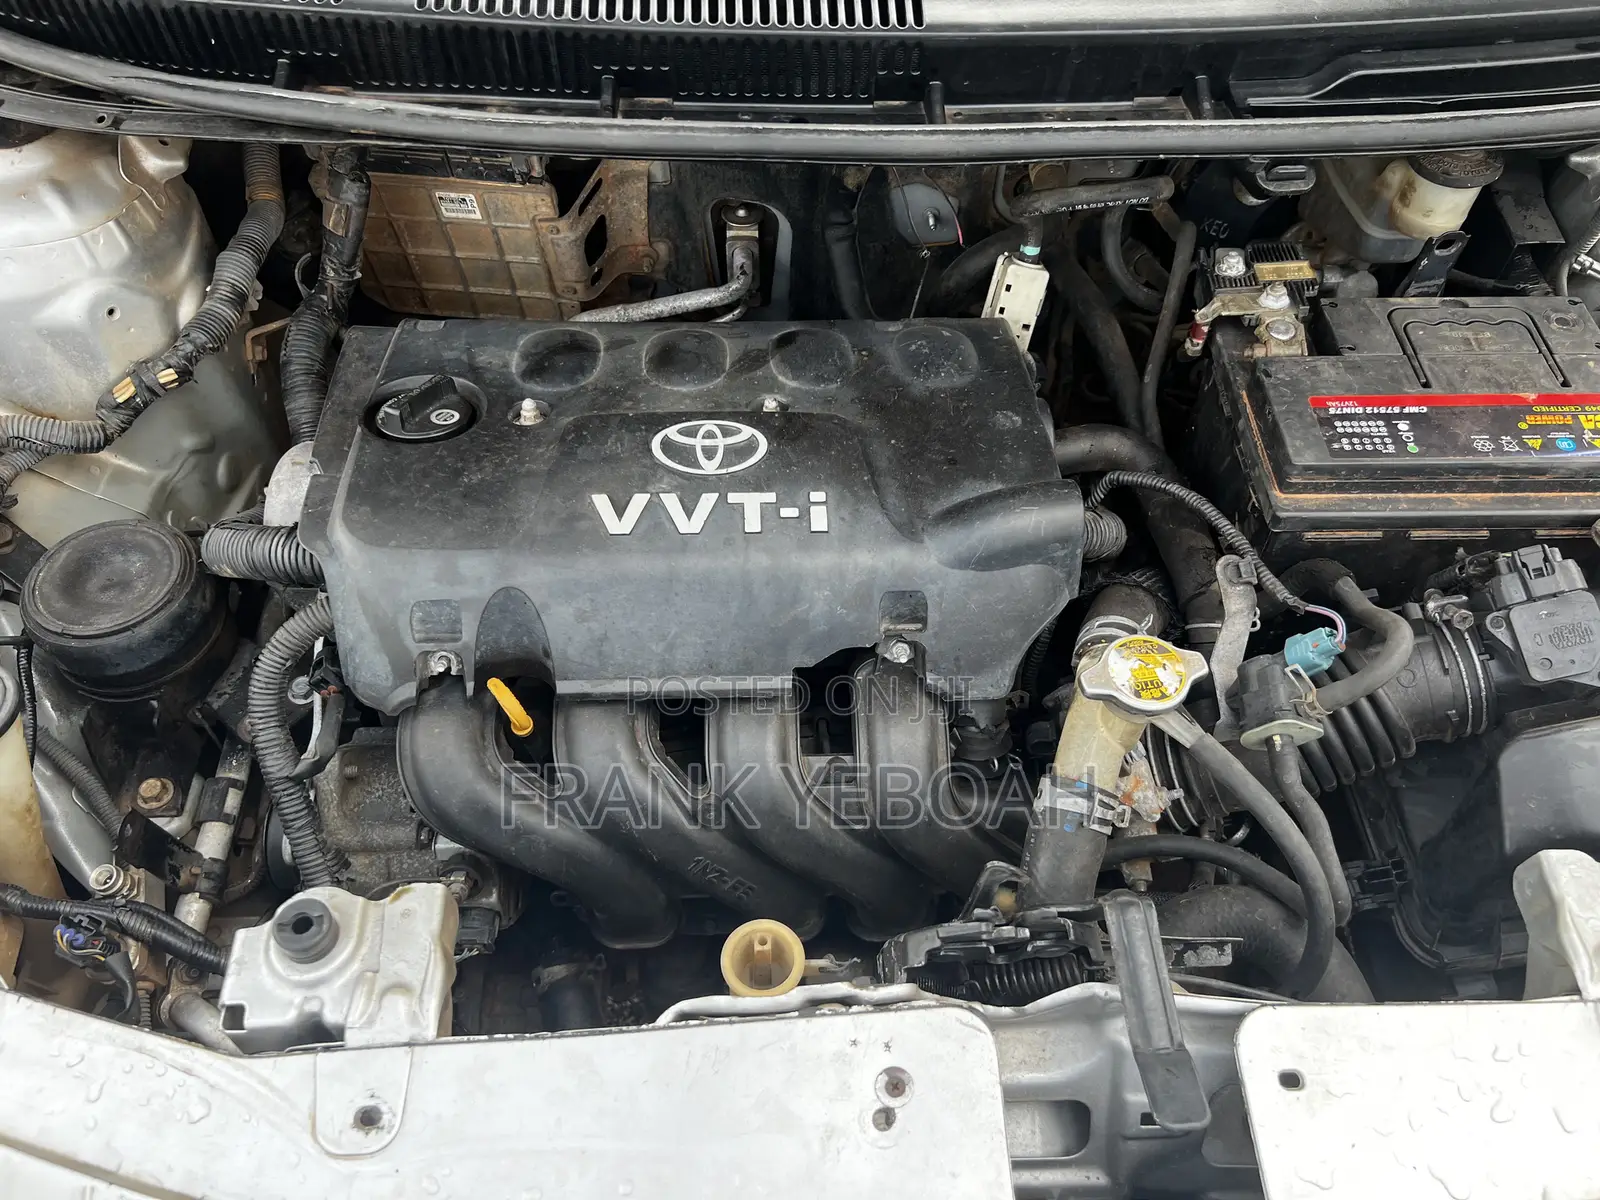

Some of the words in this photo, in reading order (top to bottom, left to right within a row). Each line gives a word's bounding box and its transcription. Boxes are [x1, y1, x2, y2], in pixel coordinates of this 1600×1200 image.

[1328, 406, 1364, 414] DIN75
[1365, 406, 1401, 414] 57512
[1525, 414, 1573, 425] POWER
[591, 491, 830, 535] VVT-i
